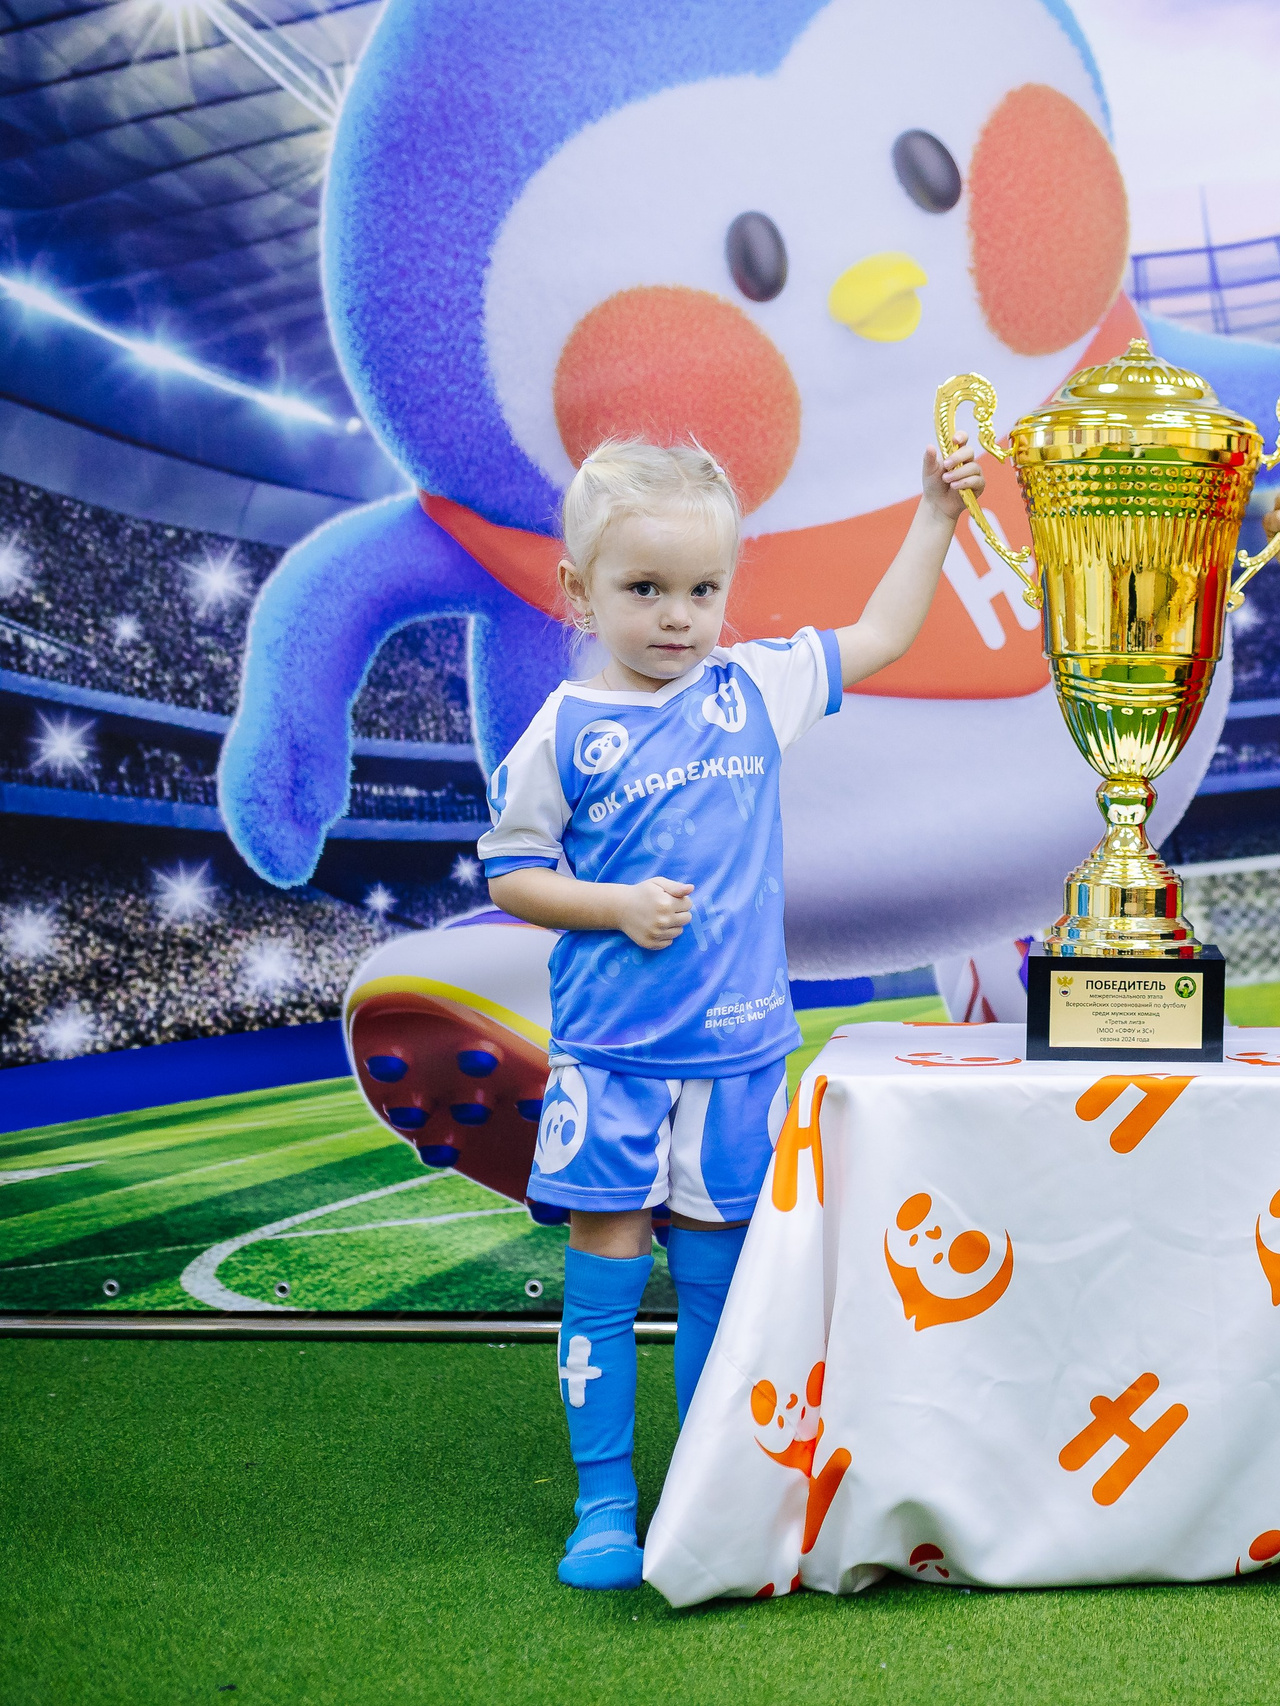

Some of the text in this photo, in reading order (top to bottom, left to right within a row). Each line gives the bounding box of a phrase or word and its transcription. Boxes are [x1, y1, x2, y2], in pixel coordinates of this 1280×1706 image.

[588, 755, 766, 823] ФК НАДЕЖДИК
[1085, 980, 1166, 992] ПОБЕДИТЕЛЬ
[706, 1002, 745, 1018] ВПЕРЁД
[745, 1001, 754, 1011] К
[705, 1014, 746, 1029] ВМЕСТЕ
[747, 1009, 766, 1022] МЫ
